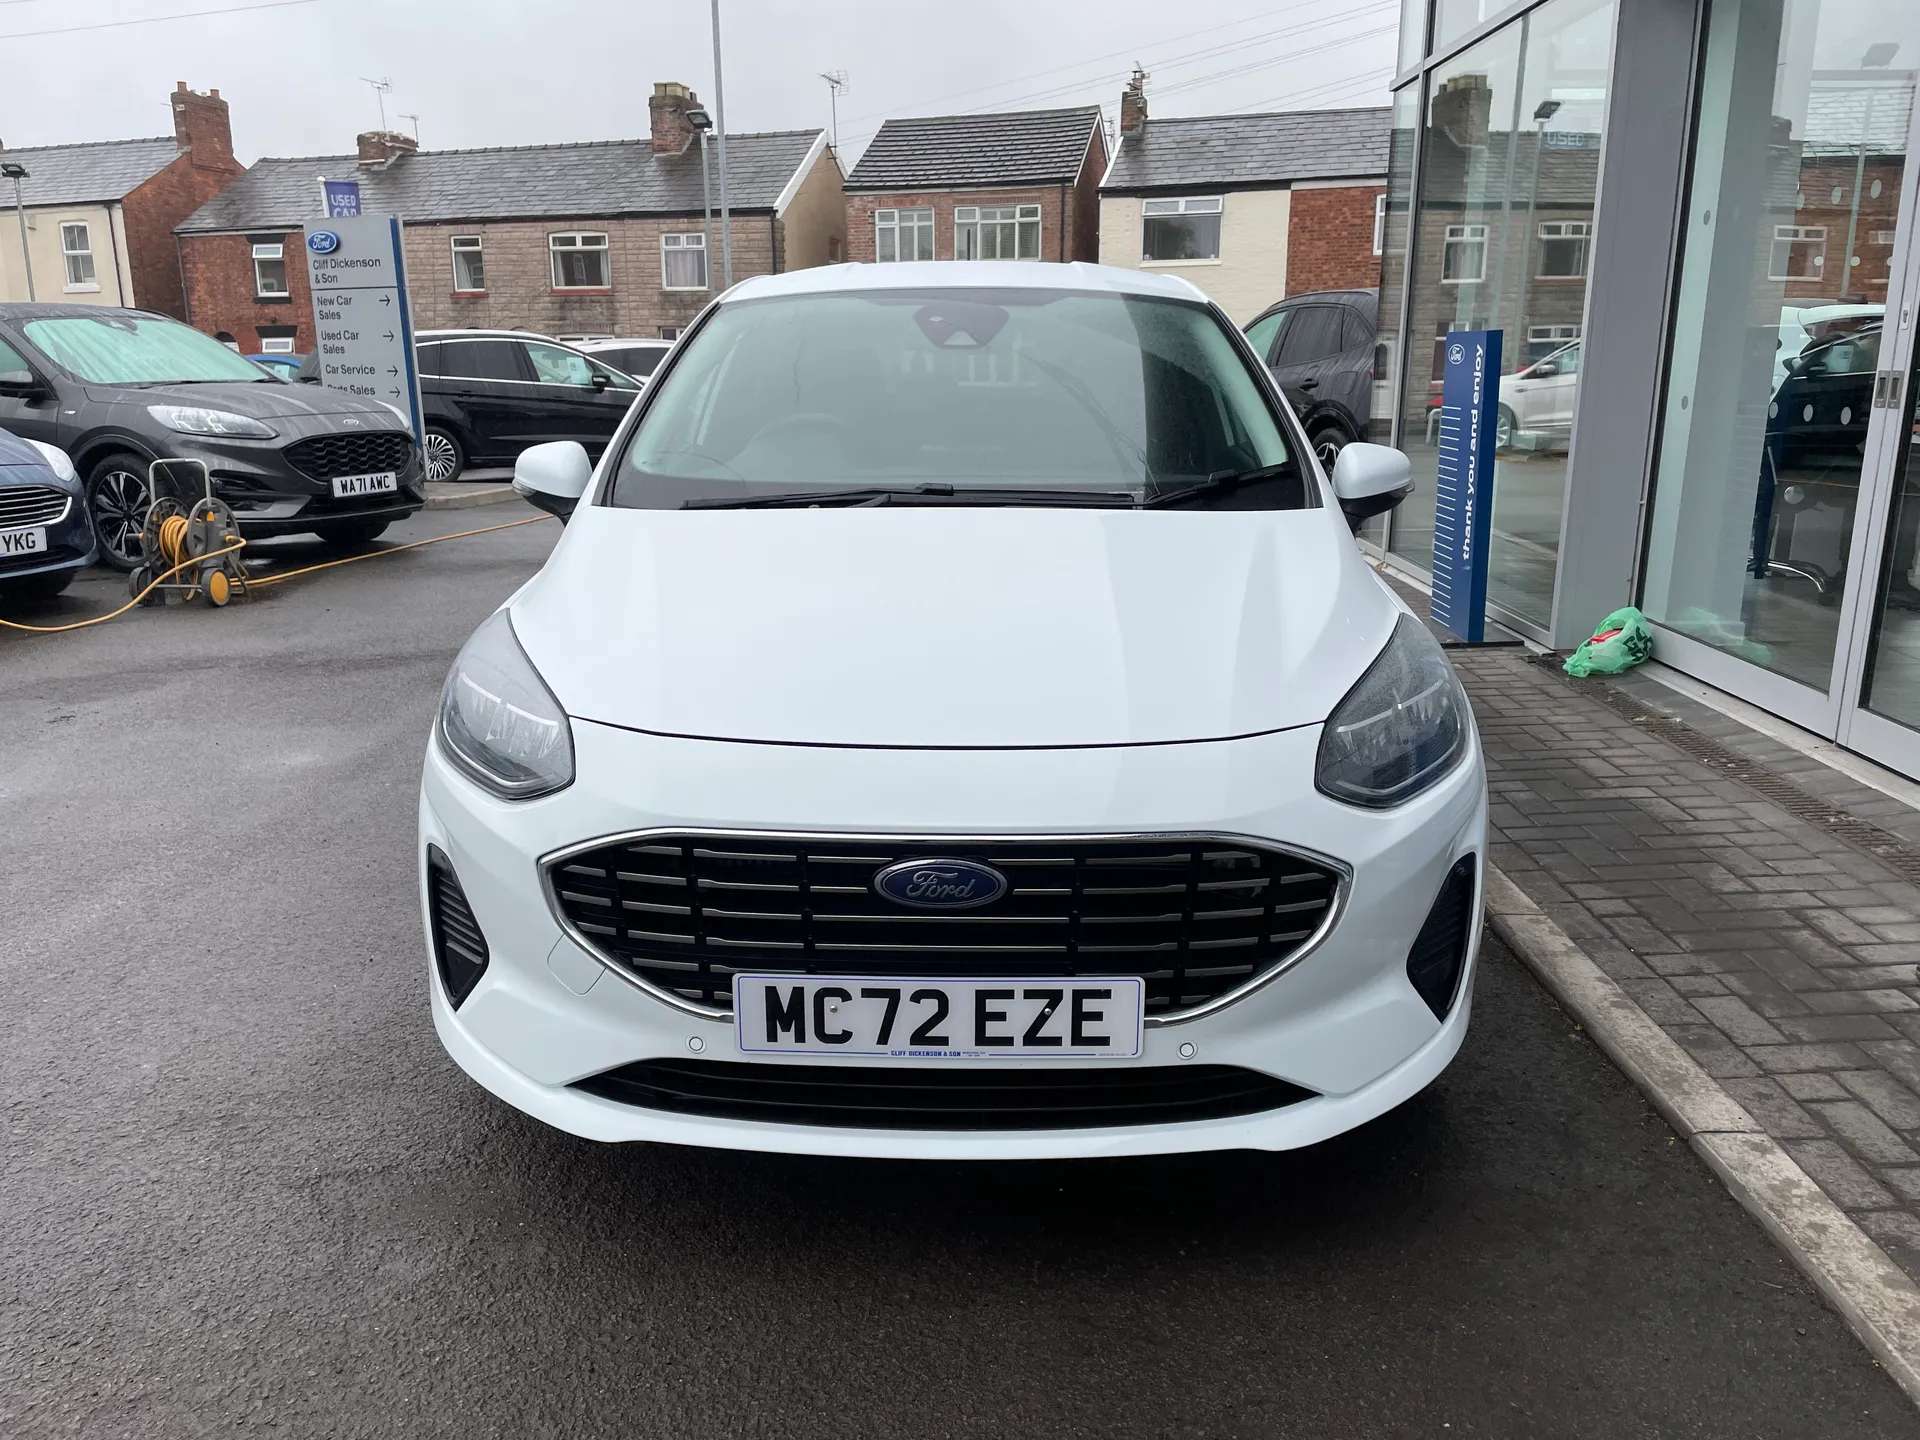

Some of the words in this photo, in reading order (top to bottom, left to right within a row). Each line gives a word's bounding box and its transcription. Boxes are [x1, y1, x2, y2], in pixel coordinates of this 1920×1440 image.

[330, 194, 357, 206] USED
[312, 234, 331, 249] Ford
[312, 258, 329, 271] Cliff
[330, 257, 381, 269] Dickenson
[315, 273, 320, 284] &
[321, 272, 338, 284] Son
[316, 295, 335, 306] New
[336, 295, 352, 306] Car
[319, 309, 341, 321] Sales
[320, 329, 342, 341] Used
[343, 329, 359, 341] Car
[322, 343, 345, 354] Sales
[325, 363, 339, 375] Car
[340, 363, 376, 375] Service
[1472, 343, 1484, 405] enjoy
[1470, 409, 1479, 452] and
[1467, 455, 1476, 495] you
[340, 477, 368, 494] WA71
[369, 474, 391, 491] AWC
[1462, 499, 1473, 561] thank
[1, 531, 36, 553] YKG
[905, 869, 977, 899] Ford
[764, 985, 950, 1047] MC72
[974, 988, 1113, 1047] EZE
